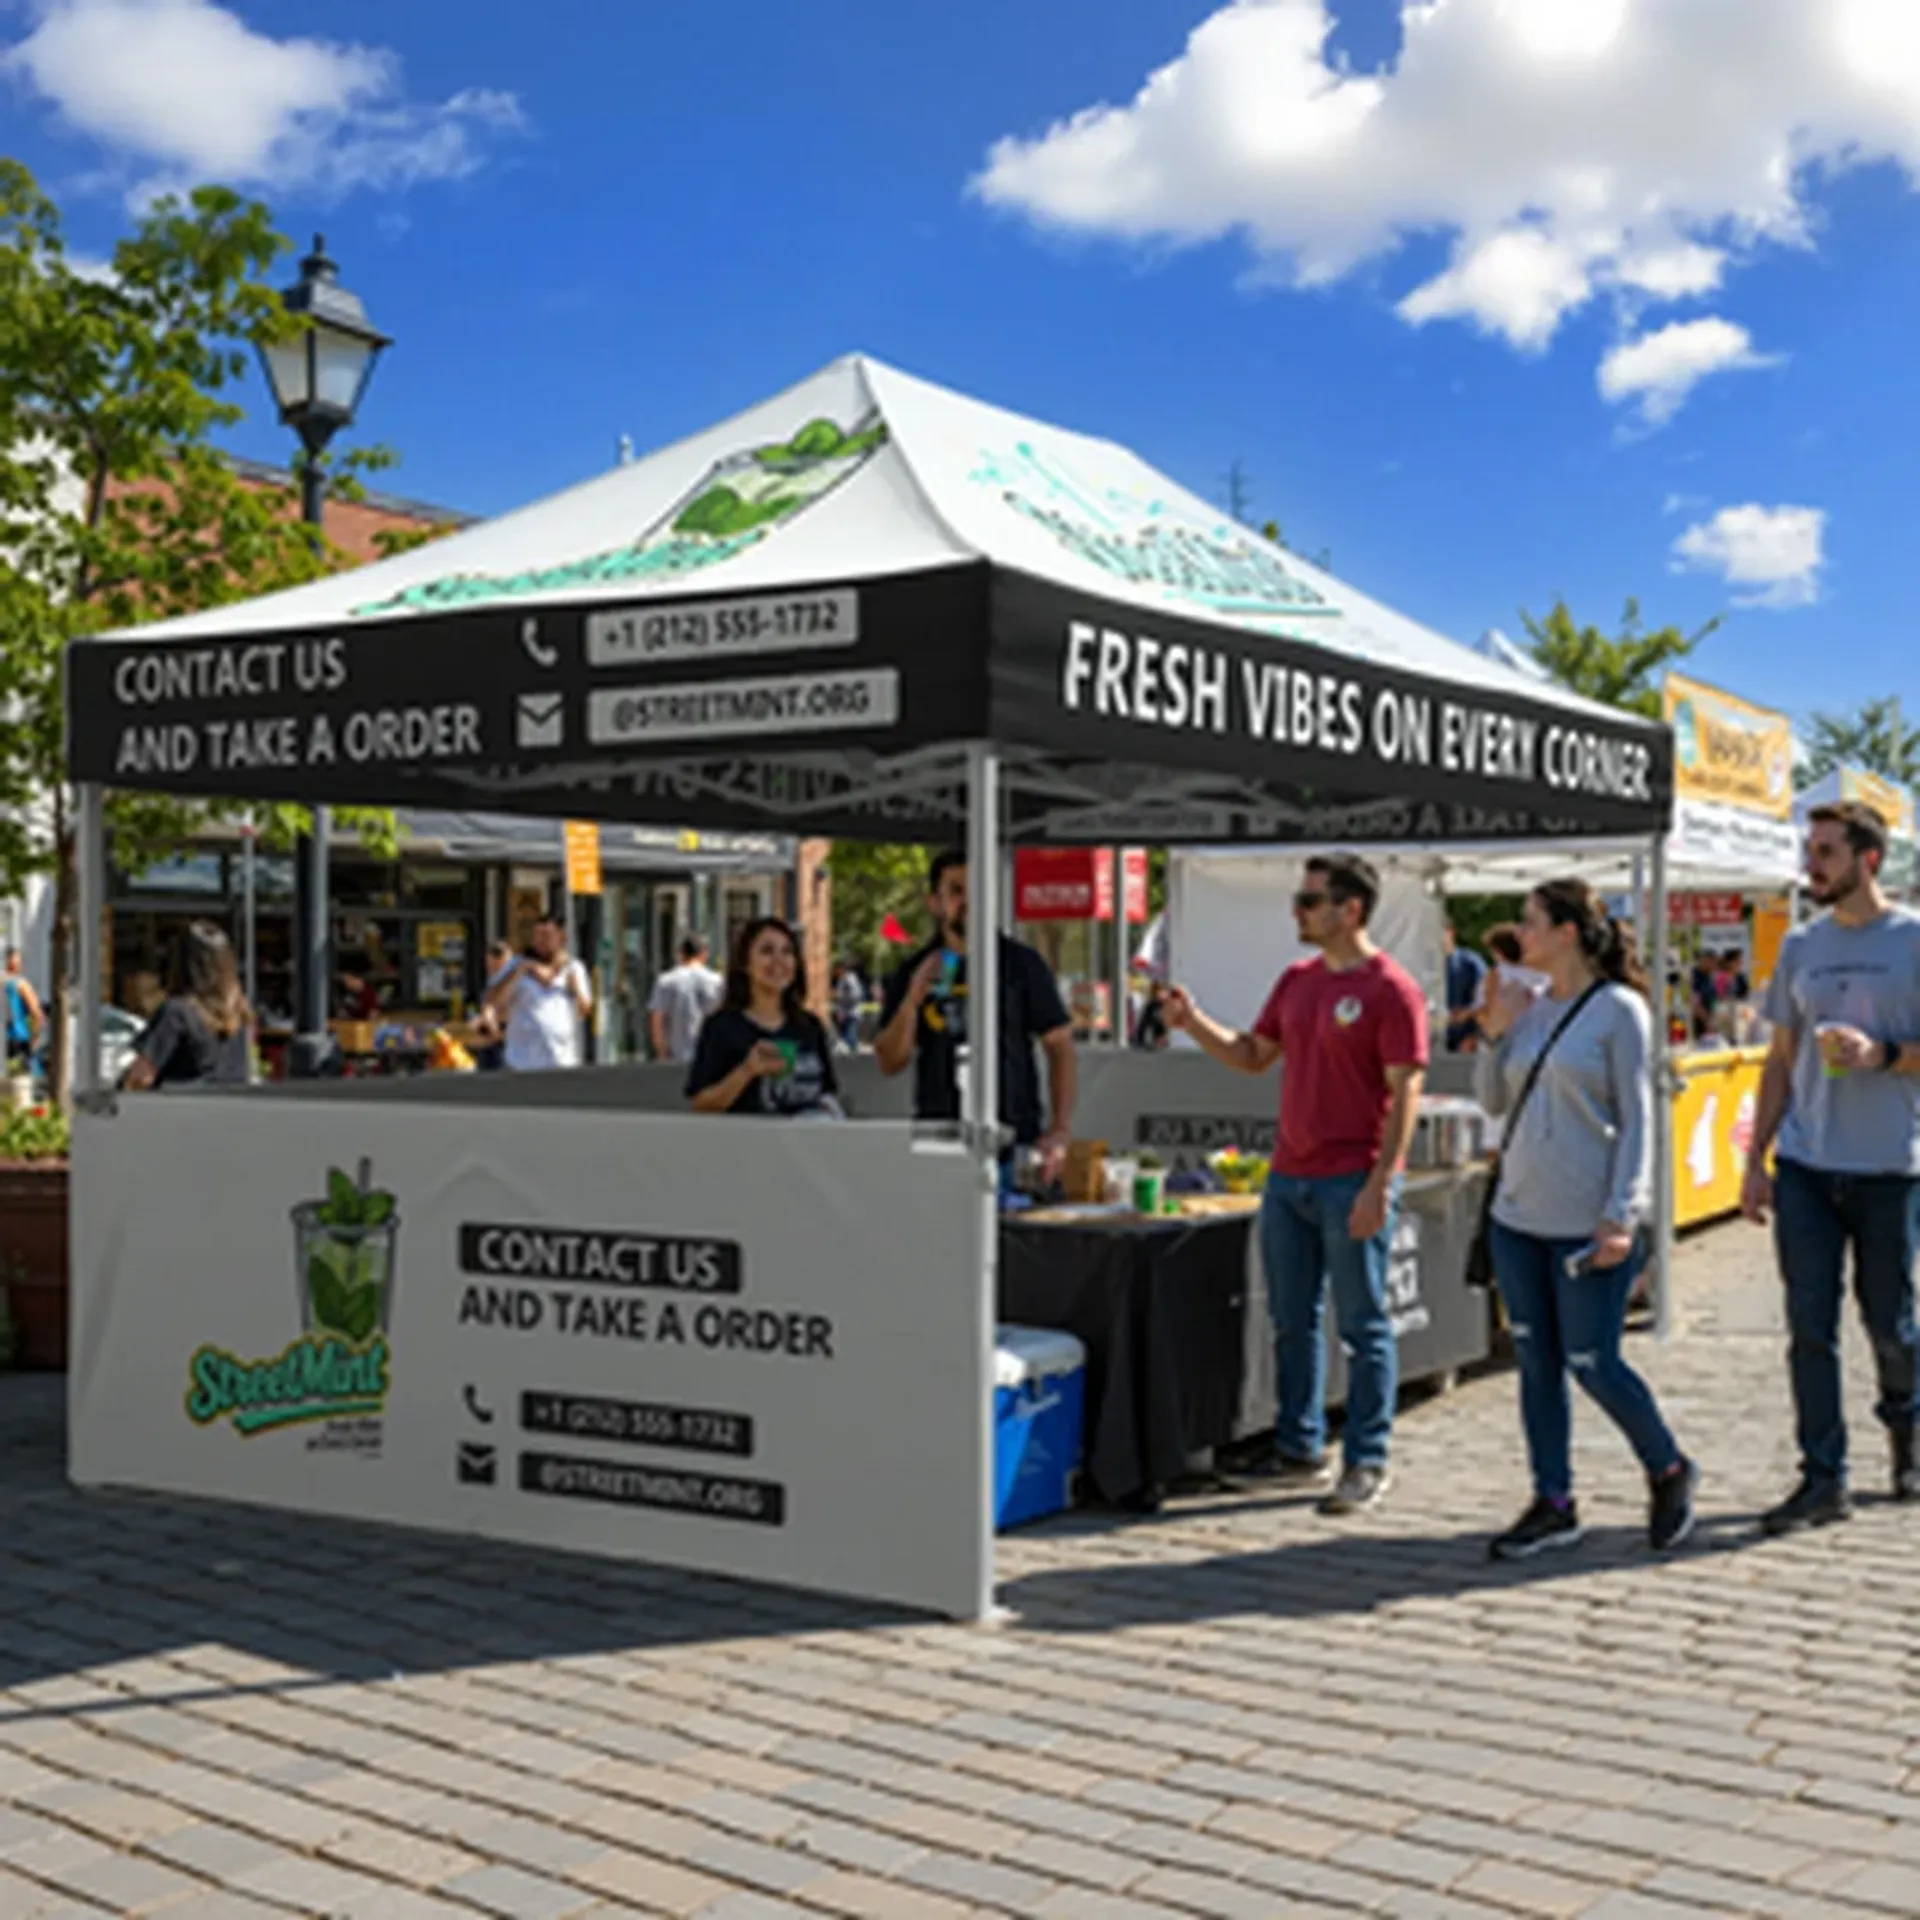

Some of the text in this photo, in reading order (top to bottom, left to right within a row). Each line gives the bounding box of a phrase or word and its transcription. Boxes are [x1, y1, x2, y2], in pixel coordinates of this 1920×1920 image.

[606, 620, 635, 648] +1
[642, 612, 709, 652] (212)
[115, 638, 348, 703] CONTACT US
[115, 705, 482, 774] AND TAKE A ORDER
[1063, 620, 1227, 732] FRESH
[1243, 659, 1361, 756] VIBES
[1373, 690, 1431, 768] ON
[1441, 704, 1539, 782] EVERY
[1542, 727, 1652, 802] CORNER
[478, 1229, 722, 1288] CONTACT US
[458, 1286, 834, 1359] AND TAKE A ORDER
